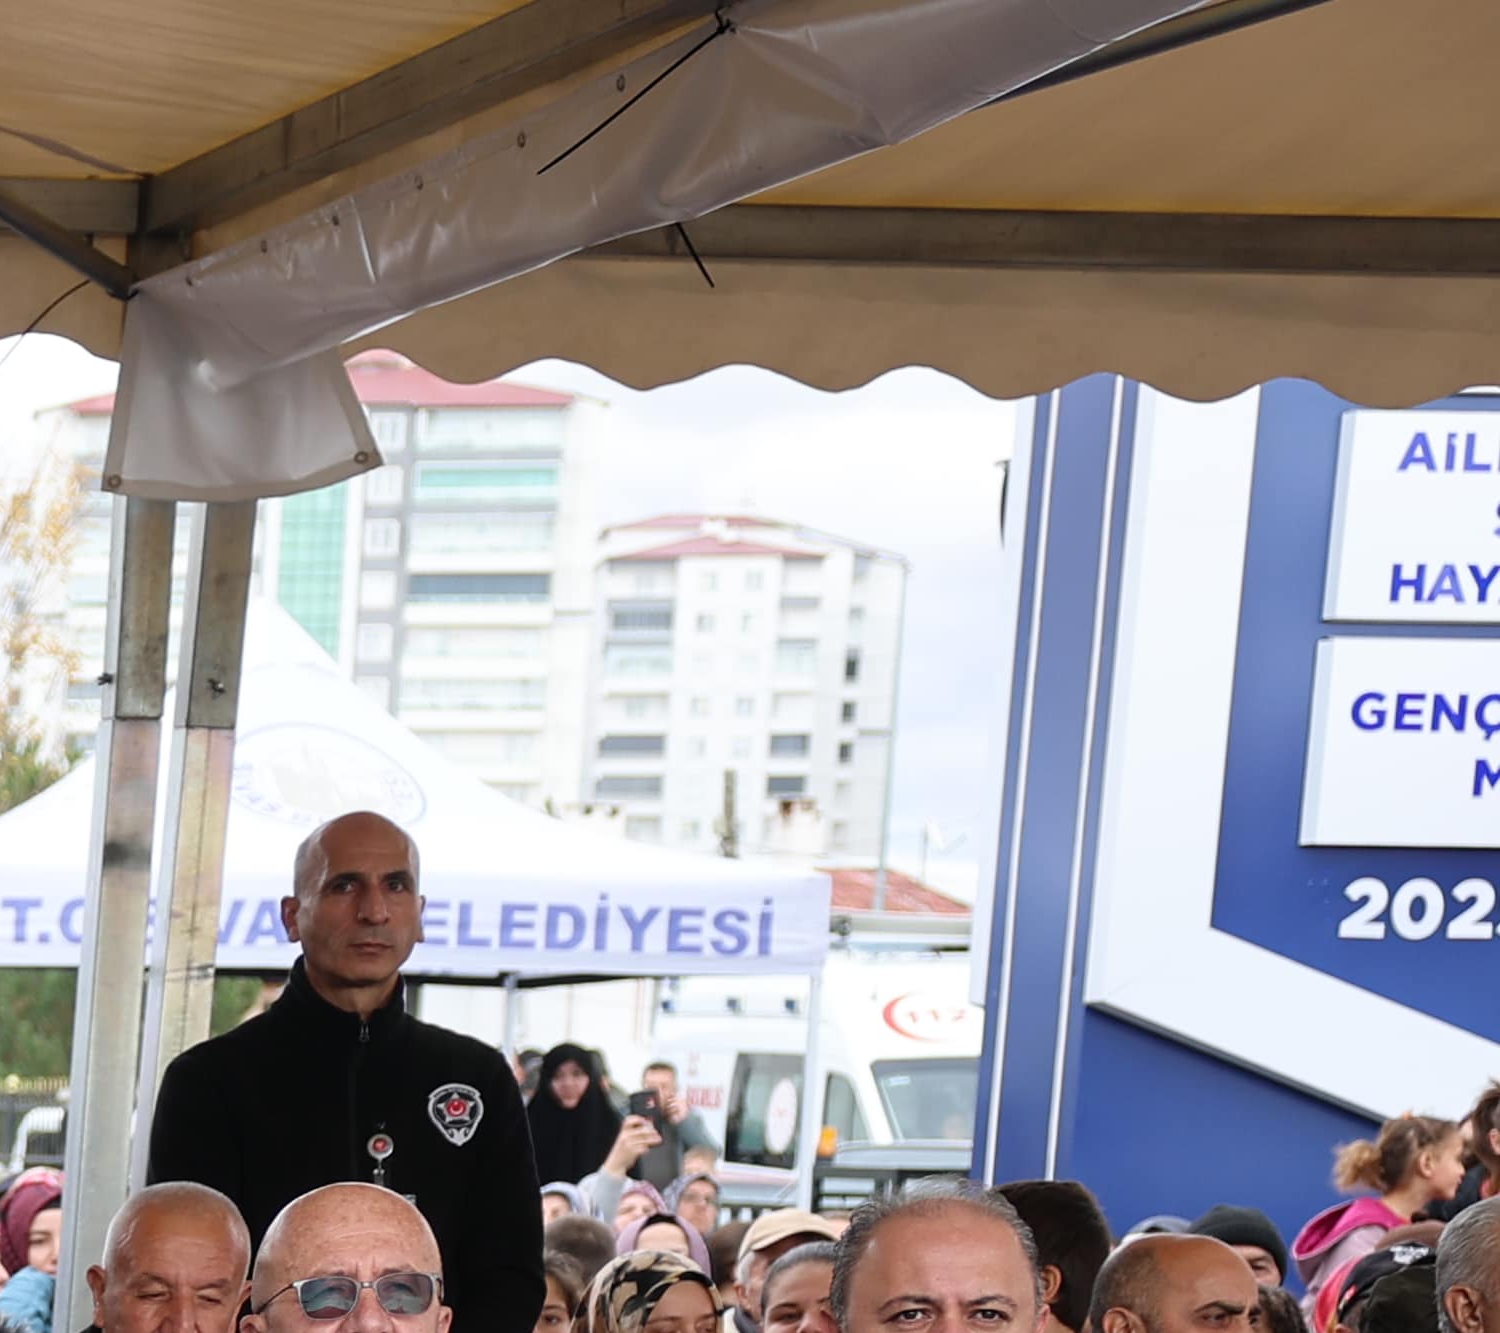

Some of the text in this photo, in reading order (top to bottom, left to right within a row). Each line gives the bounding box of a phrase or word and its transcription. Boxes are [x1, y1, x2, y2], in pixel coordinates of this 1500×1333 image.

[1398, 431, 1500, 472] AİL
[1389, 563, 1500, 603] HAY
[422, 892, 775, 956] ELEDİYESİ
[1337, 876, 1500, 941] 202
